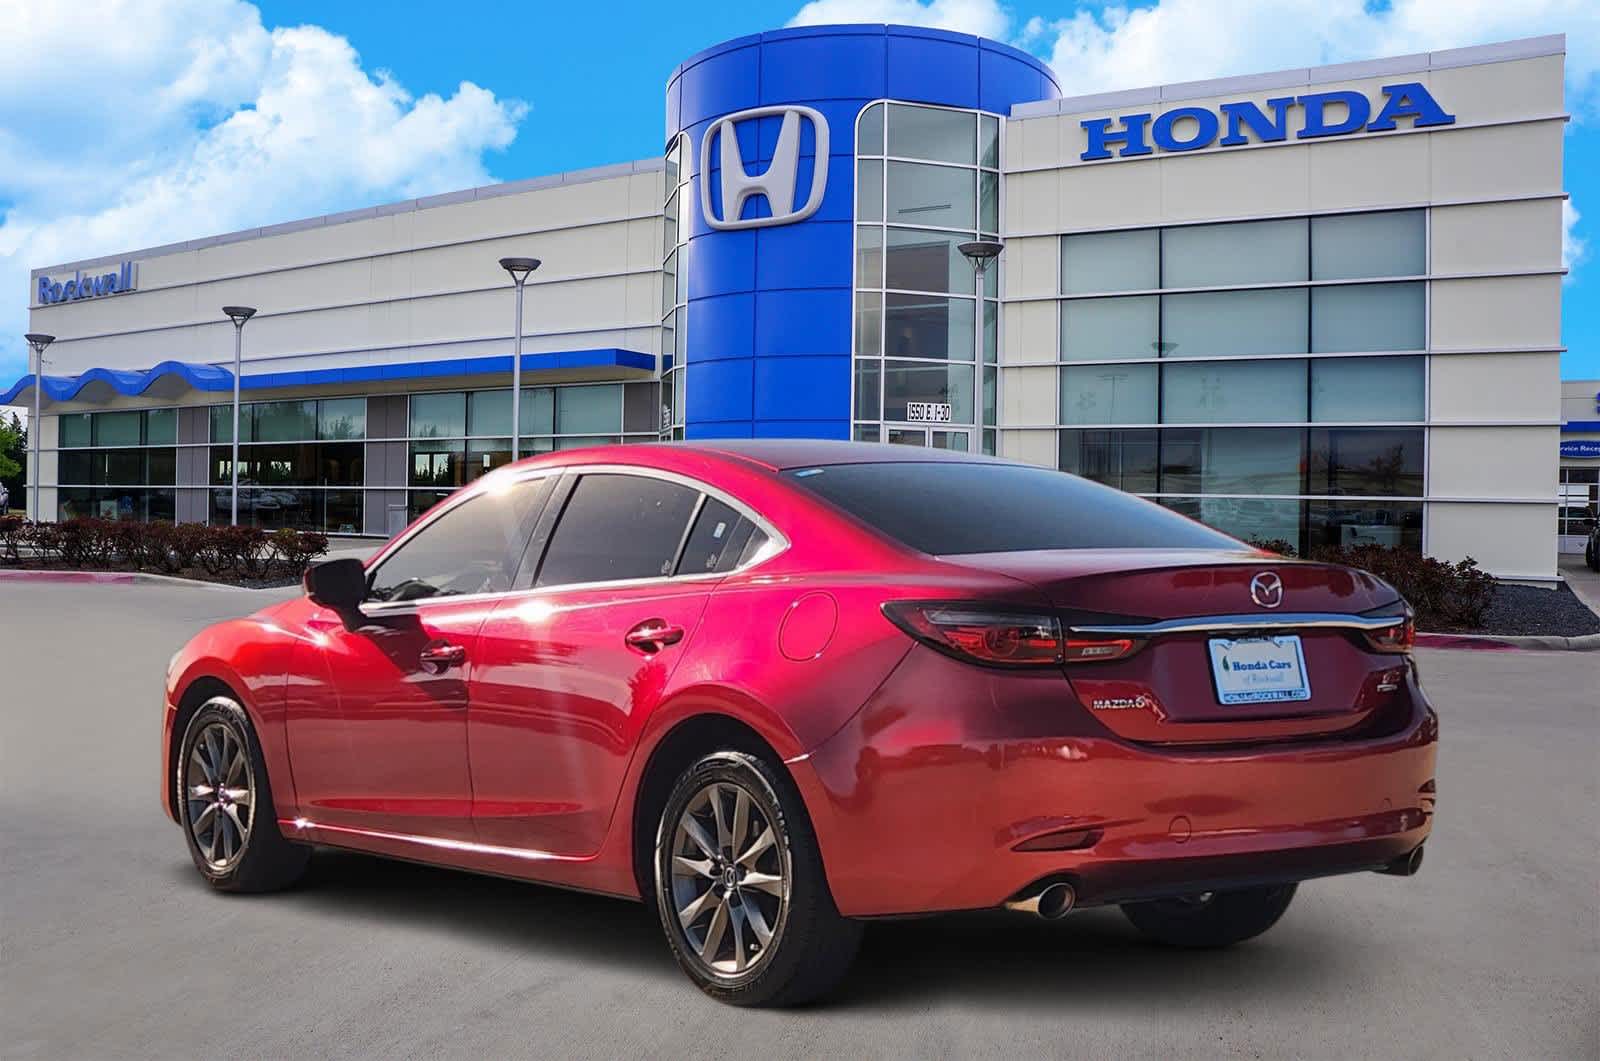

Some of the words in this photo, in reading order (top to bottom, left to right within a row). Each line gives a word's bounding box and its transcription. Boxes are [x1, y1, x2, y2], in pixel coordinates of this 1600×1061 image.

[1080, 82, 1456, 161] HONDA
[38, 261, 132, 304] Rockwall
[908, 404, 925, 420] 1550
[1232, 660, 1268, 671] Honda
[1269, 659, 1292, 670] Cars
